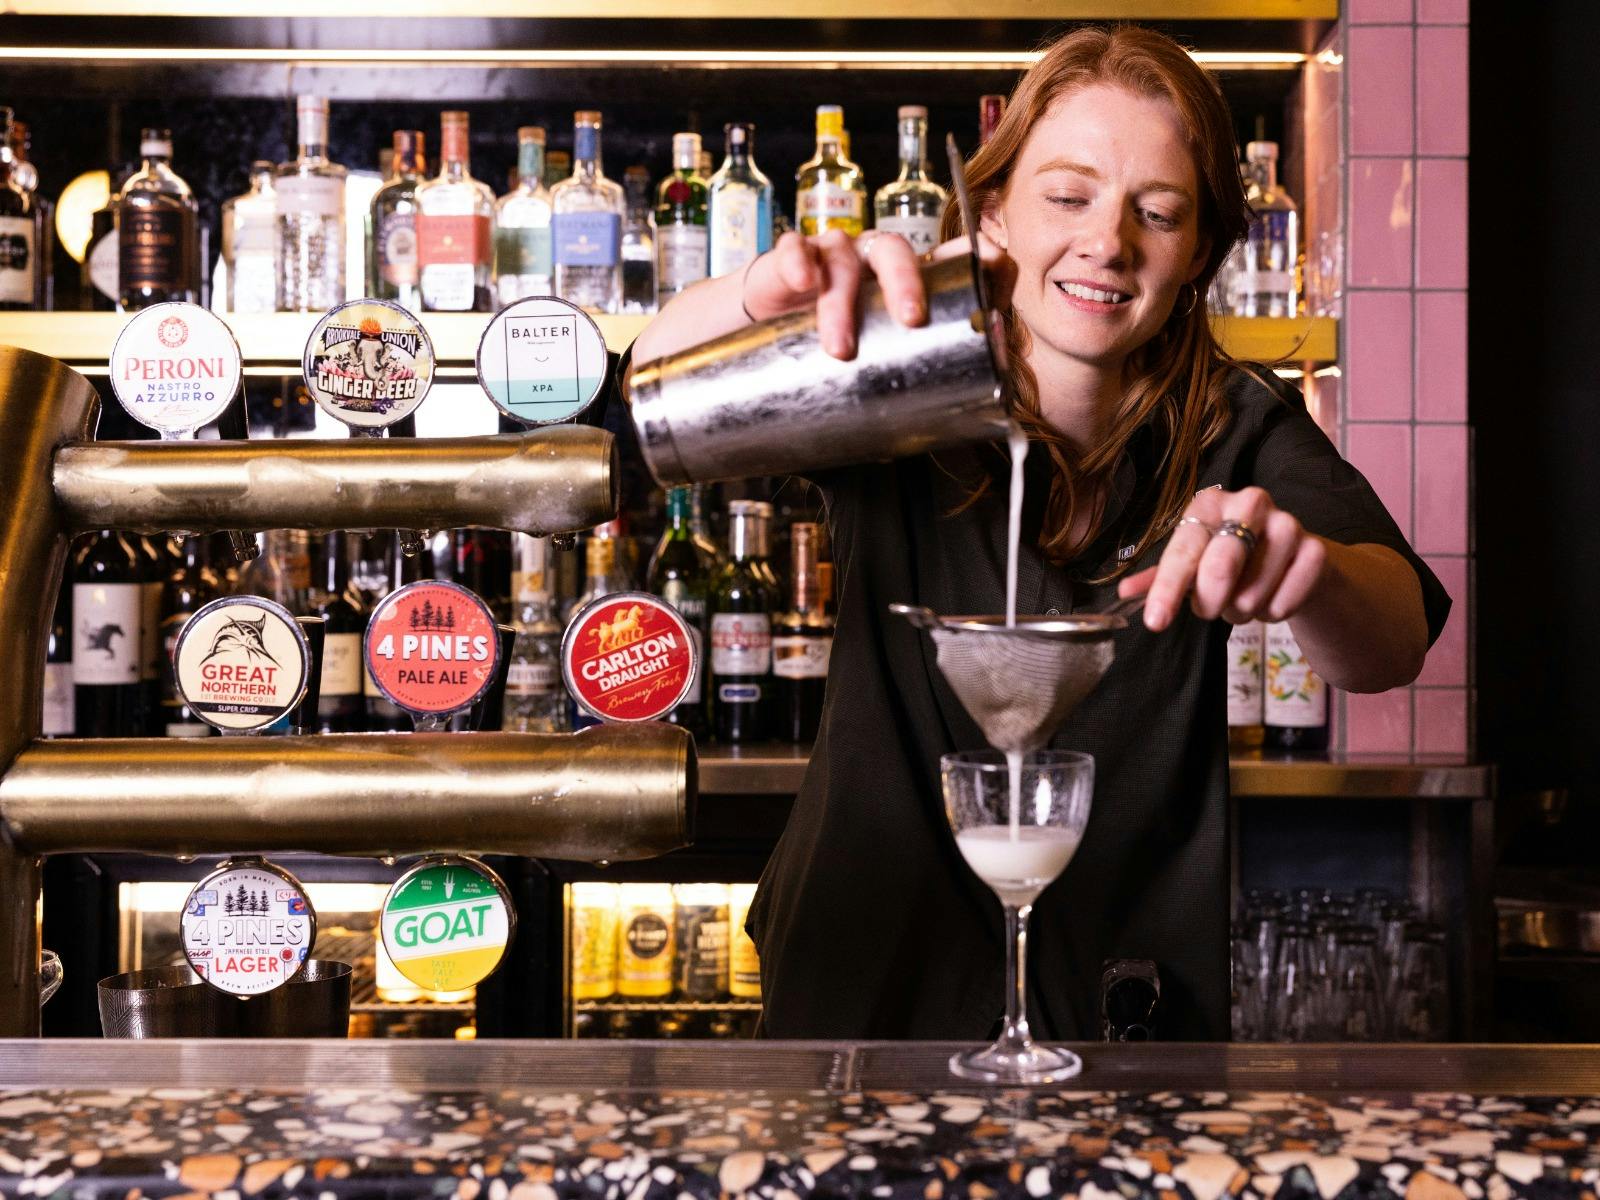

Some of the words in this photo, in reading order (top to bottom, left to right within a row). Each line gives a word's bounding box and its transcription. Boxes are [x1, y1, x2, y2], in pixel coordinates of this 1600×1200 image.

[512, 327, 570, 338] BALTER
[326, 328, 361, 348] BROOKVALE
[381, 332, 416, 356] UNION
[124, 358, 224, 380] PERONI
[148, 382, 201, 391] NASTRO
[318, 370, 373, 399] GINGER
[532, 384, 553, 392] XPA
[135, 392, 215, 403] AZZURRO
[376, 634, 395, 660] 4
[402, 634, 489, 662] PINES
[581, 632, 677, 681] CARLTON
[202, 664, 277, 684] GREAT
[398, 670, 435, 684] PALE
[439, 670, 468, 685] ALE
[599, 655, 670, 692] DRAUGHT
[201, 682, 277, 696] NORTHERN
[607, 686, 655, 710] Brewery
[213, 694, 251, 703] BREWING
[218, 705, 239, 713] SUPER
[240, 706, 259, 714] CRISP
[219, 876, 237, 886] BORN
[252, 875, 275, 886] MANLY
[191, 919, 210, 946] 4
[217, 918, 303, 946] PINES
[394, 904, 492, 947] GOAT
[215, 957, 279, 973] LAGER
